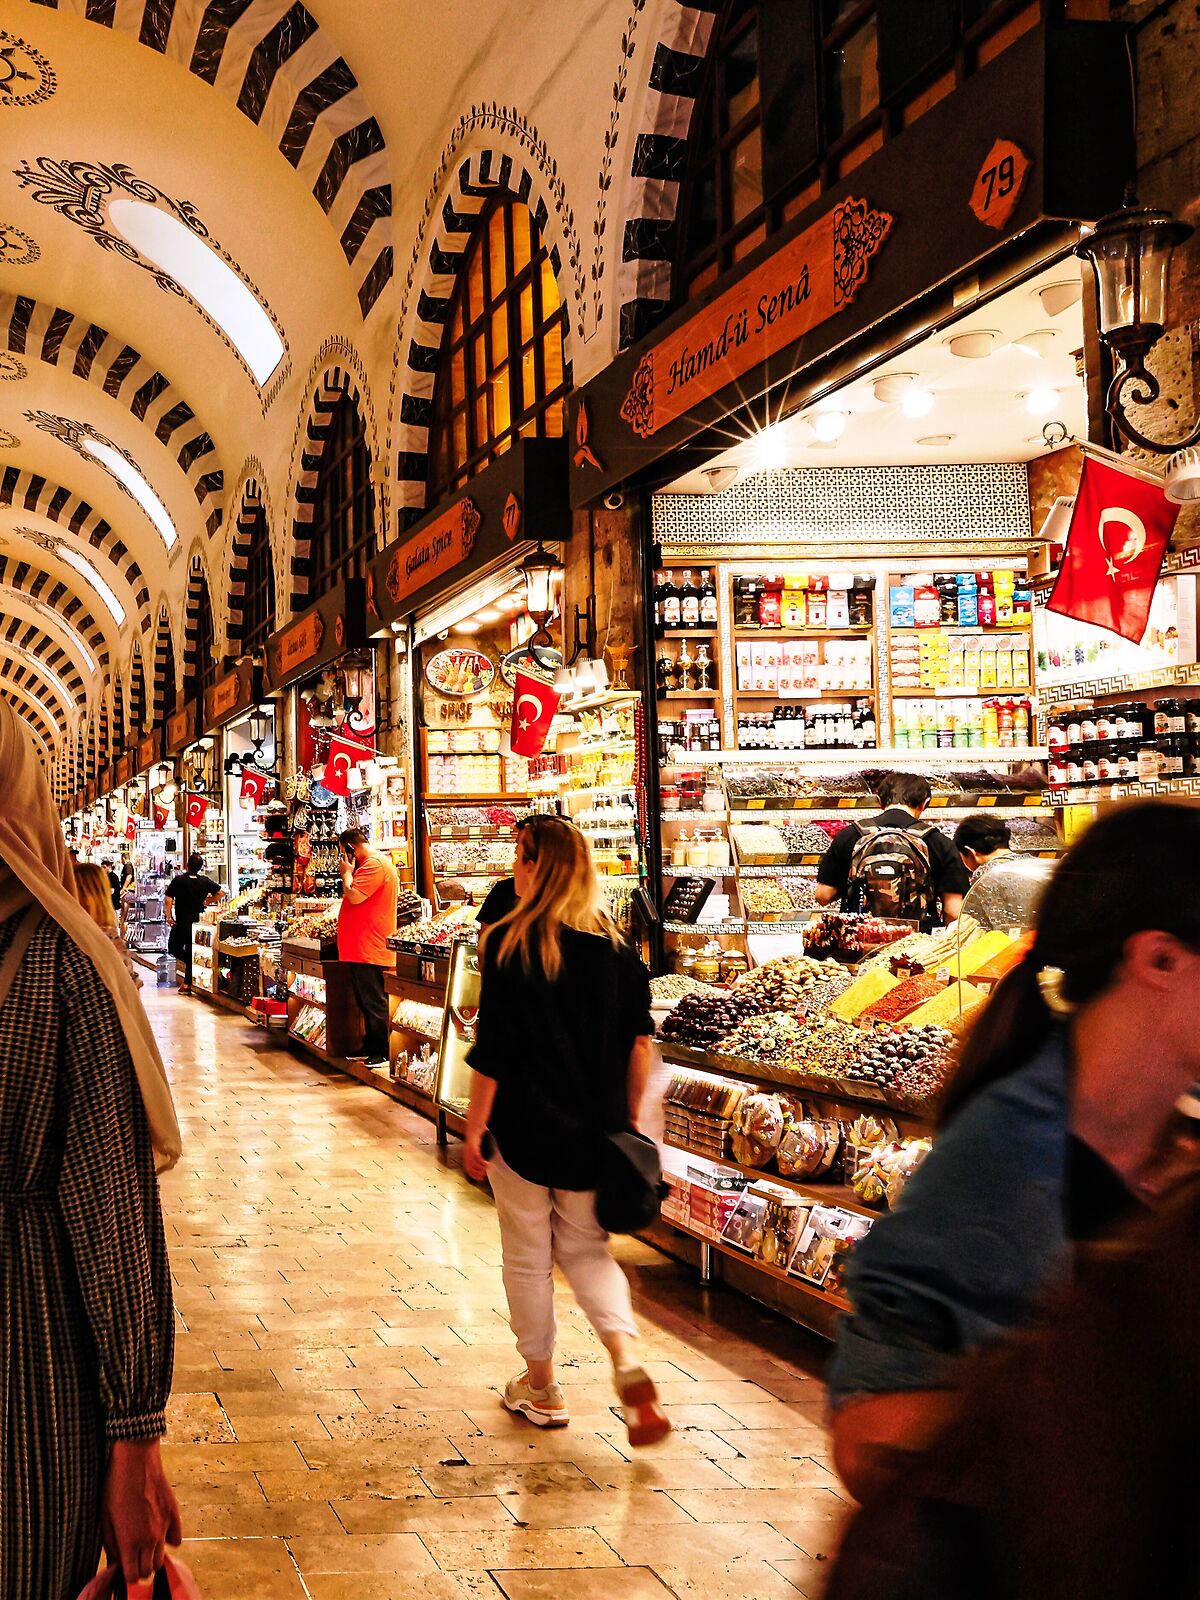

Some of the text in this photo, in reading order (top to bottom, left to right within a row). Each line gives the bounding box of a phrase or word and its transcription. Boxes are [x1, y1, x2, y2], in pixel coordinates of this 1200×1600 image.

[981, 155, 1015, 211] 79
[666, 263, 812, 395] Hamd-ü Senâ
[505, 503, 516, 529] 77
[405, 529, 453, 581] Galata Spice
